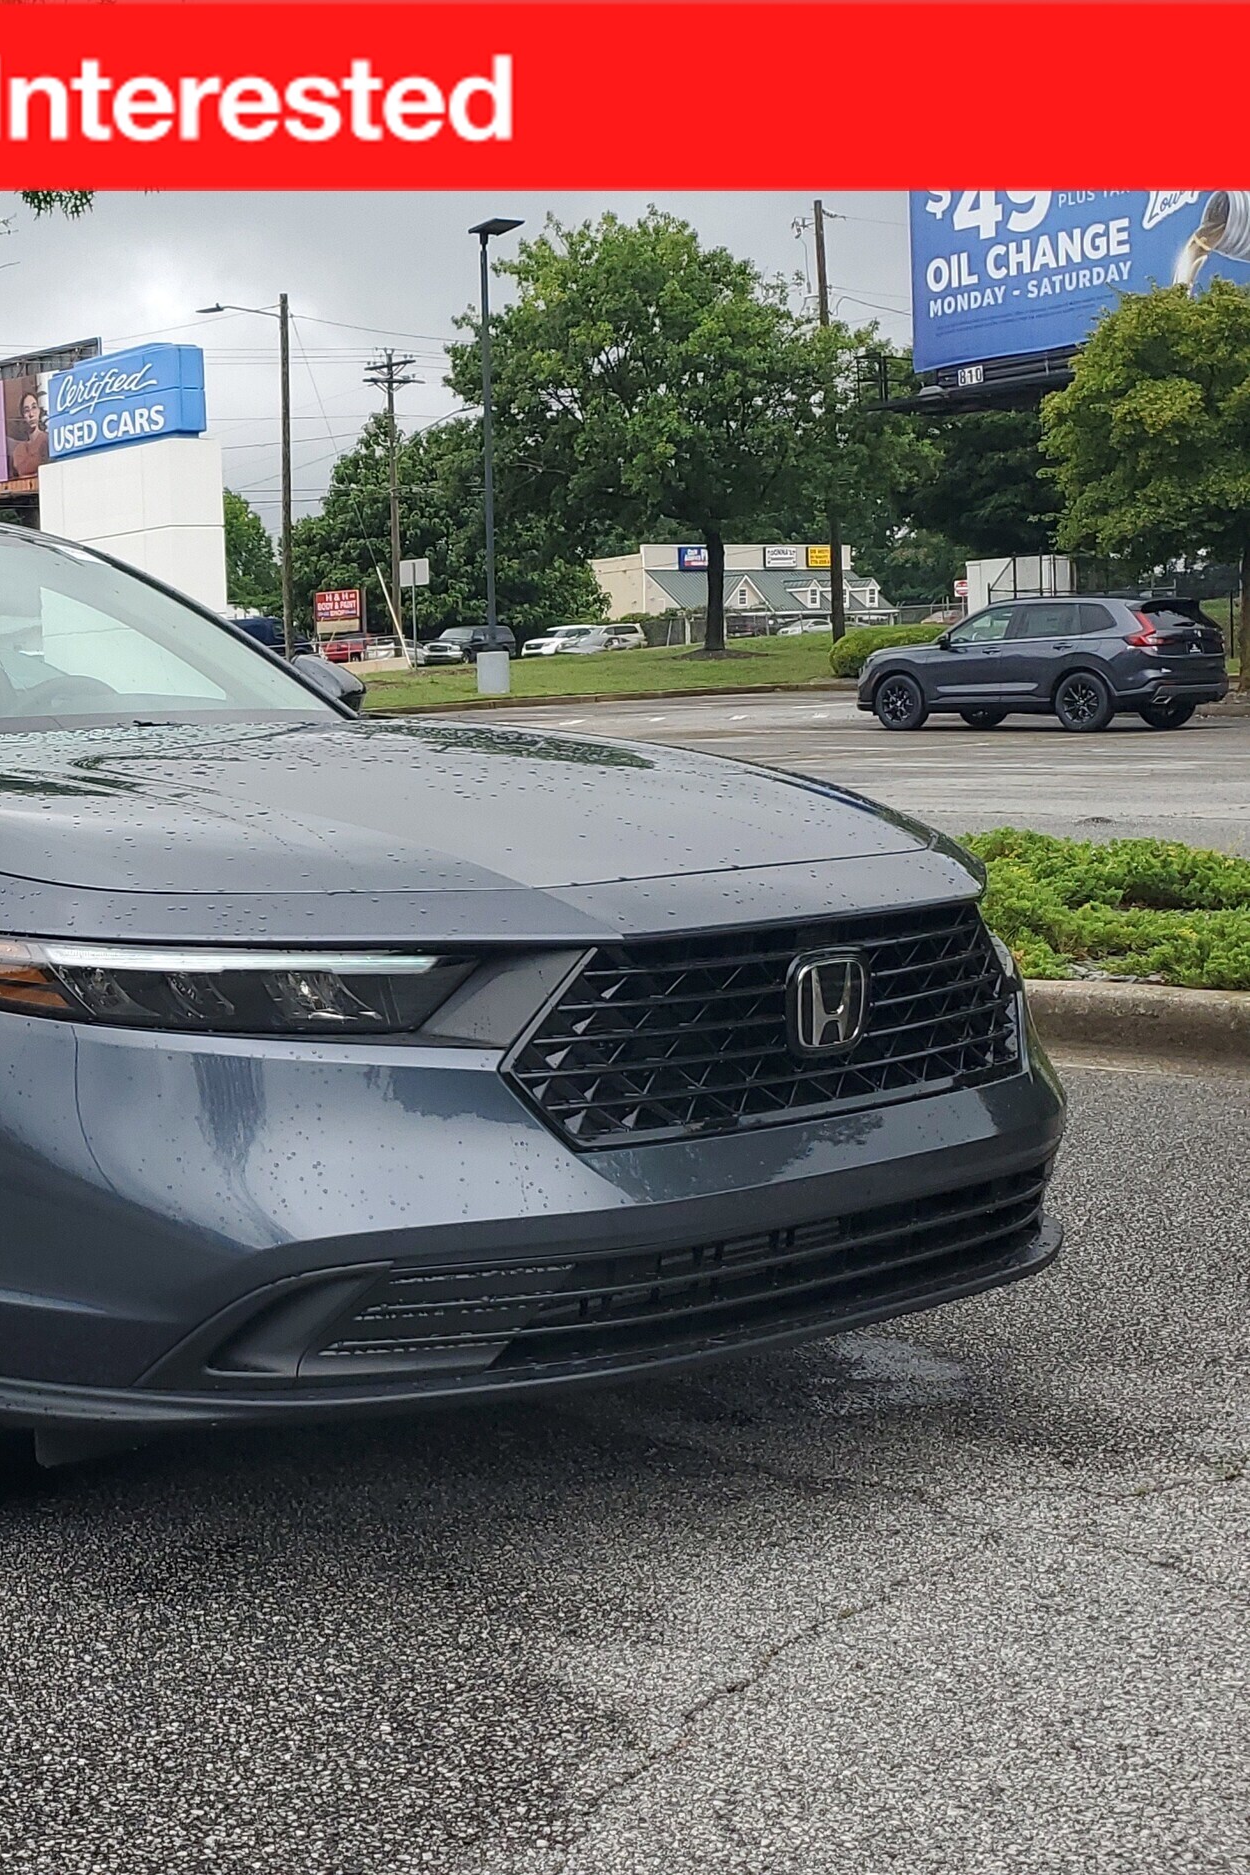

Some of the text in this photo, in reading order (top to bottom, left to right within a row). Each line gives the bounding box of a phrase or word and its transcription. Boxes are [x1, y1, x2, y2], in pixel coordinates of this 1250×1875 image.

[1058, 190, 1096, 208] PLUS
[926, 218, 1130, 293] OIL CHANGE
[929, 285, 1006, 319] MONDAY
[1027, 260, 1132, 298] SATURDAY
[57, 363, 158, 414] Certified
[959, 367, 982, 385] 810
[53, 405, 165, 452] USED CARS
[325, 593, 333, 602] H
[341, 591, 349, 601] H
